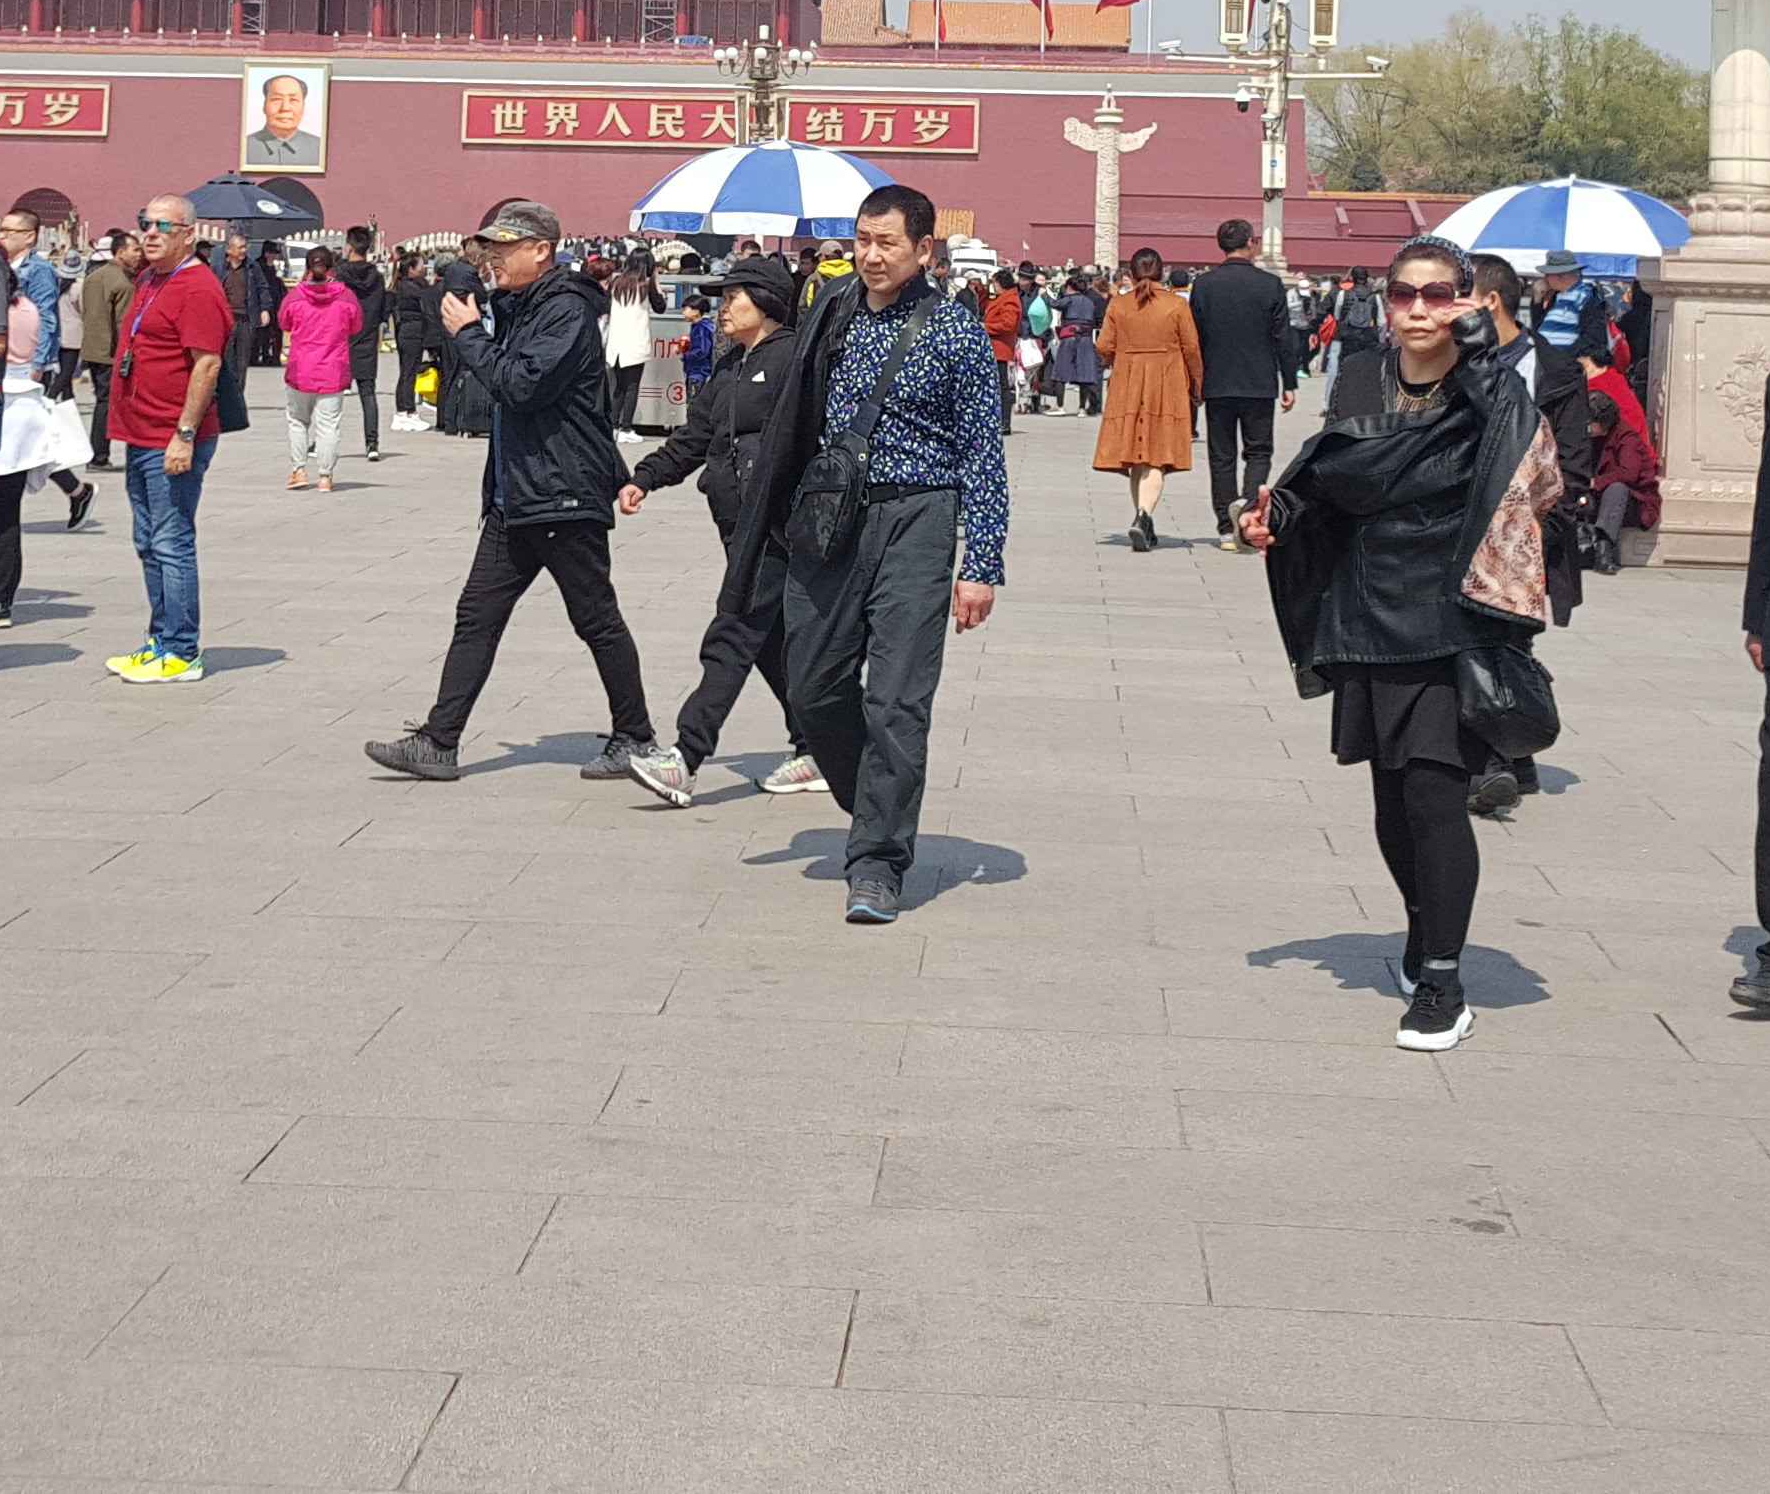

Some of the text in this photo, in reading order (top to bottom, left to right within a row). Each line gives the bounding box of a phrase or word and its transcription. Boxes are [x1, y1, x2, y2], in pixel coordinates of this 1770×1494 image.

[491, 100, 951, 145] 世界人民大结万岁
